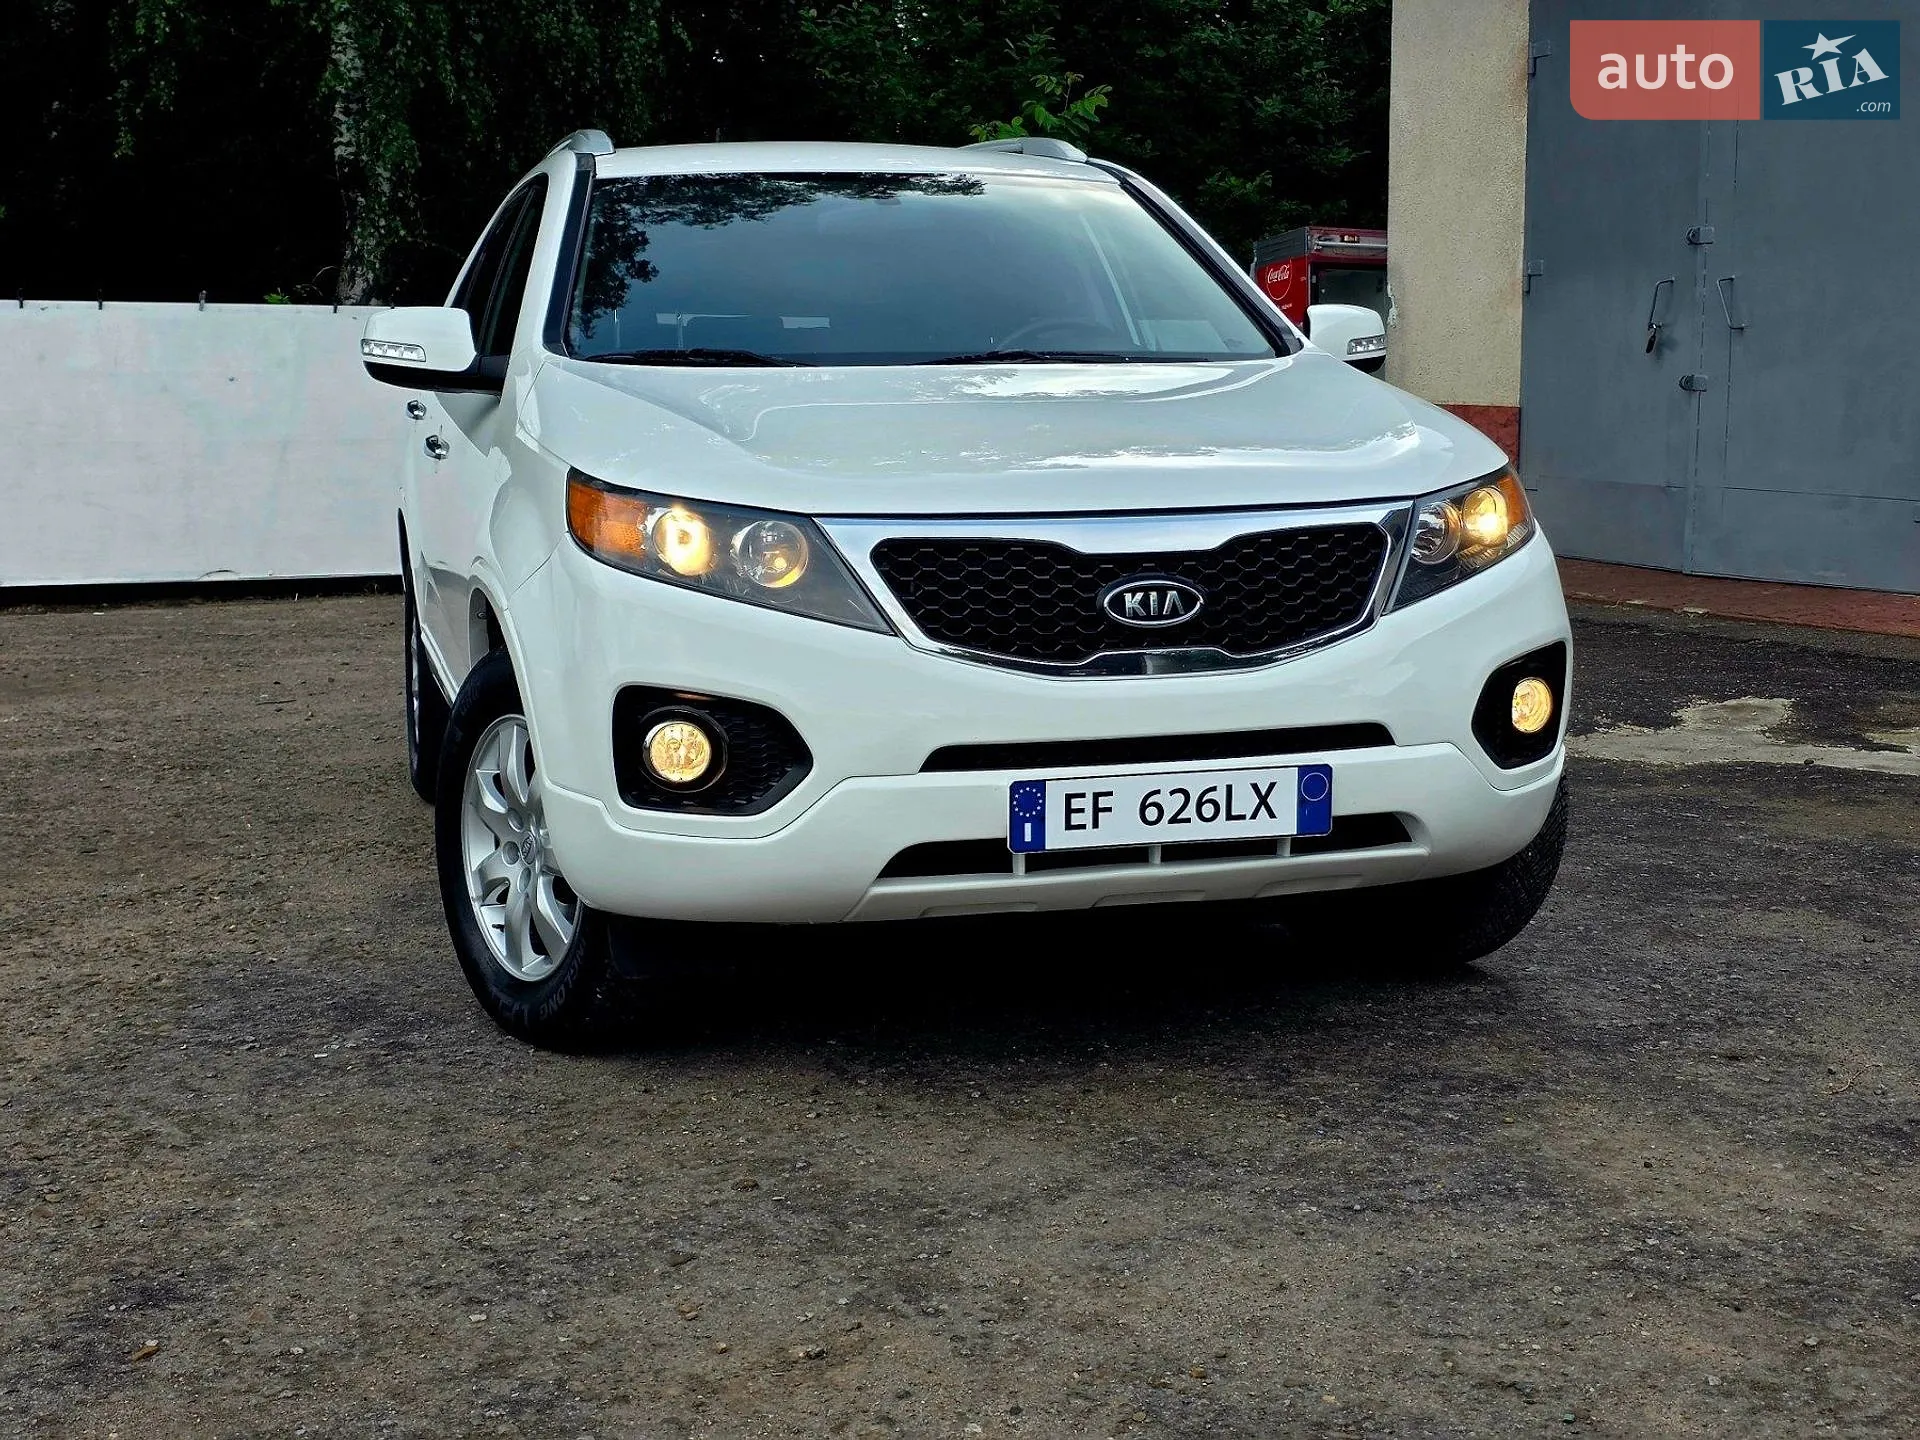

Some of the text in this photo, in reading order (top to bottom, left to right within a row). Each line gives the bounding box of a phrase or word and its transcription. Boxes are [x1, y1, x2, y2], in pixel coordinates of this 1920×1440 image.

[1123, 590, 1186, 617] KIA
[1064, 781, 1278, 832] EF 626LX
